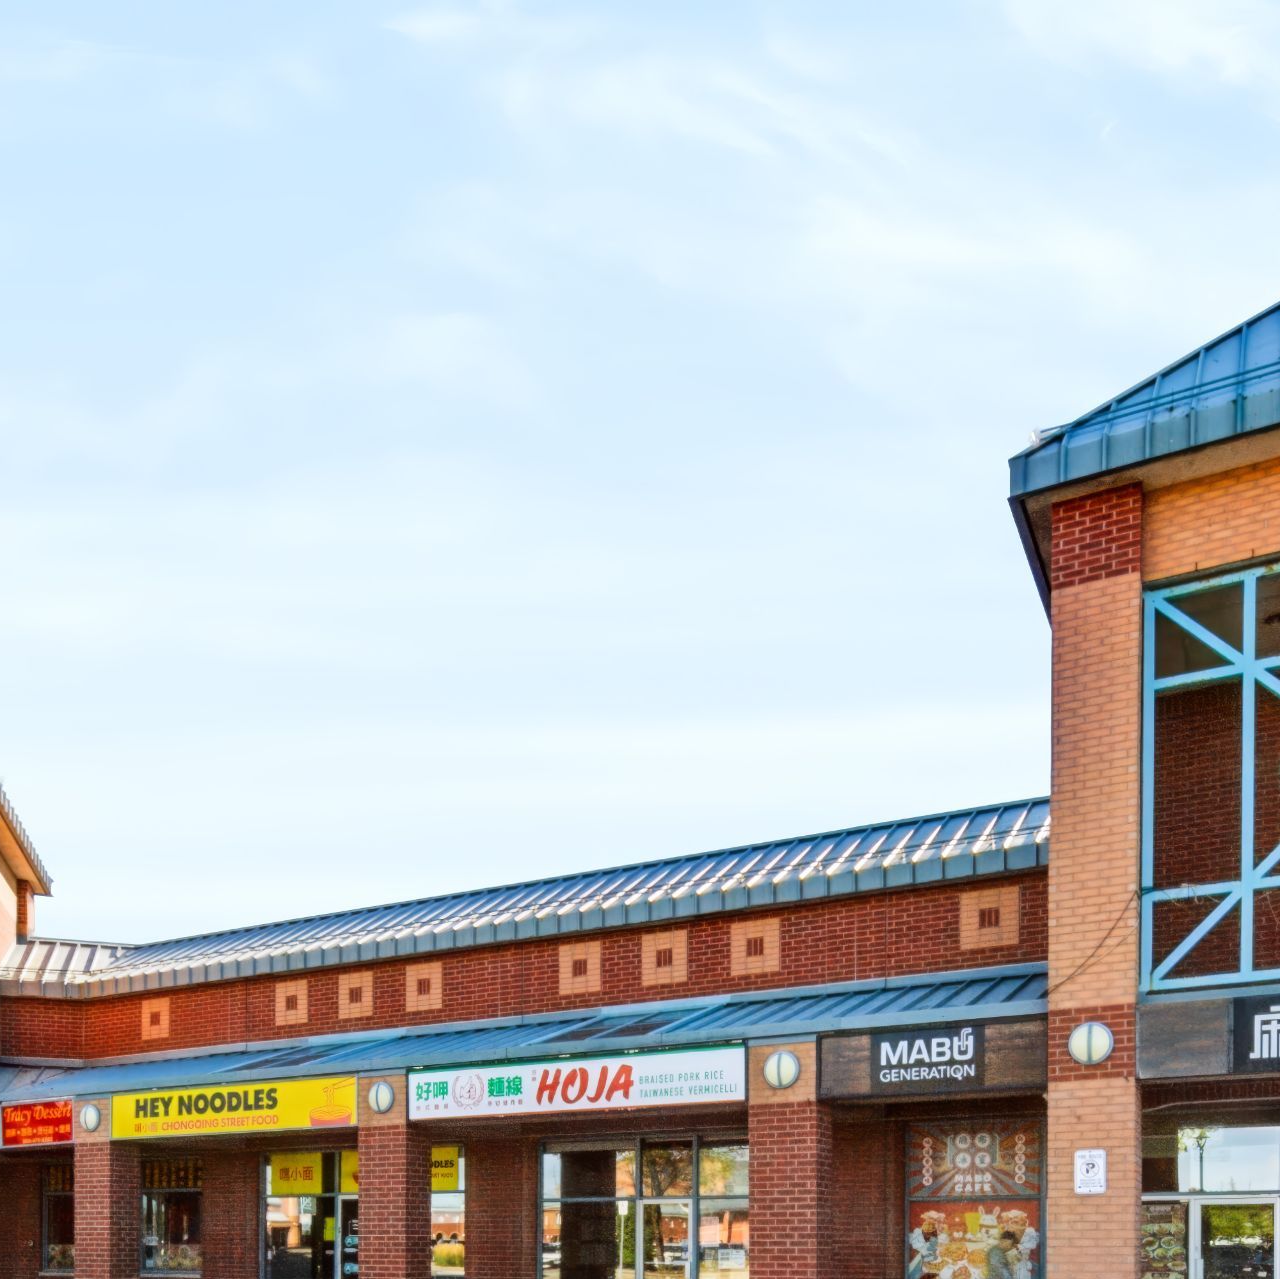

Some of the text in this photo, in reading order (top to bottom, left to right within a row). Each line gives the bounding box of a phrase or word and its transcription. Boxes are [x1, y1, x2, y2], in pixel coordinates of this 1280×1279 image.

[639, 1070, 724, 1085] BRAISED PORK RICE
[880, 1064, 975, 1083] GENERATION
[416, 1081, 448, 1101] 好呷
[536, 1064, 634, 1105] HOJA
[639, 1083, 738, 1098] TAIWANESE VERMICELLI
[134, 1087, 279, 1118] HEY NOODLES
[4, 1106, 31, 1126] Tracy
[221, 1116, 250, 1128] STREET
[251, 1114, 279, 1125] FOOD
